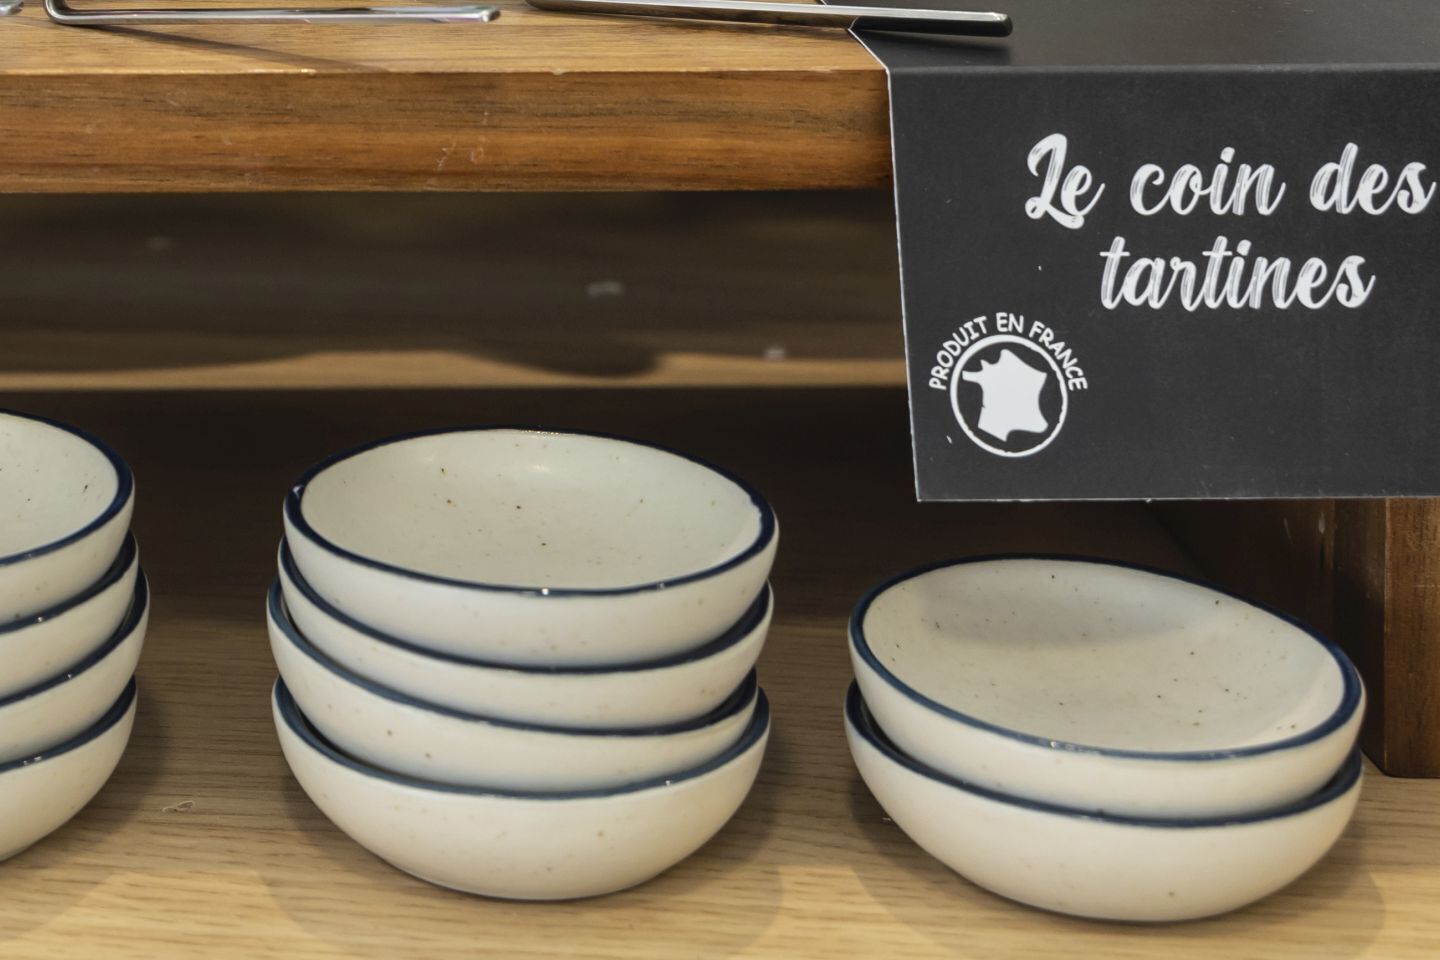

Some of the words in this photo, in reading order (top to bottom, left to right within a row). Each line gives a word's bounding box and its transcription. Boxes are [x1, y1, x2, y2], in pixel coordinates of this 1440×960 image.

[1024, 133, 1105, 229] Le
[1129, 147, 1286, 215] coin
[1309, 142, 1436, 215] des
[1099, 236, 1376, 311] tartines
[929, 315, 987, 390] PRODUIT
[996, 312, 1024, 333] EN
[1029, 321, 1088, 390] FRANCE
